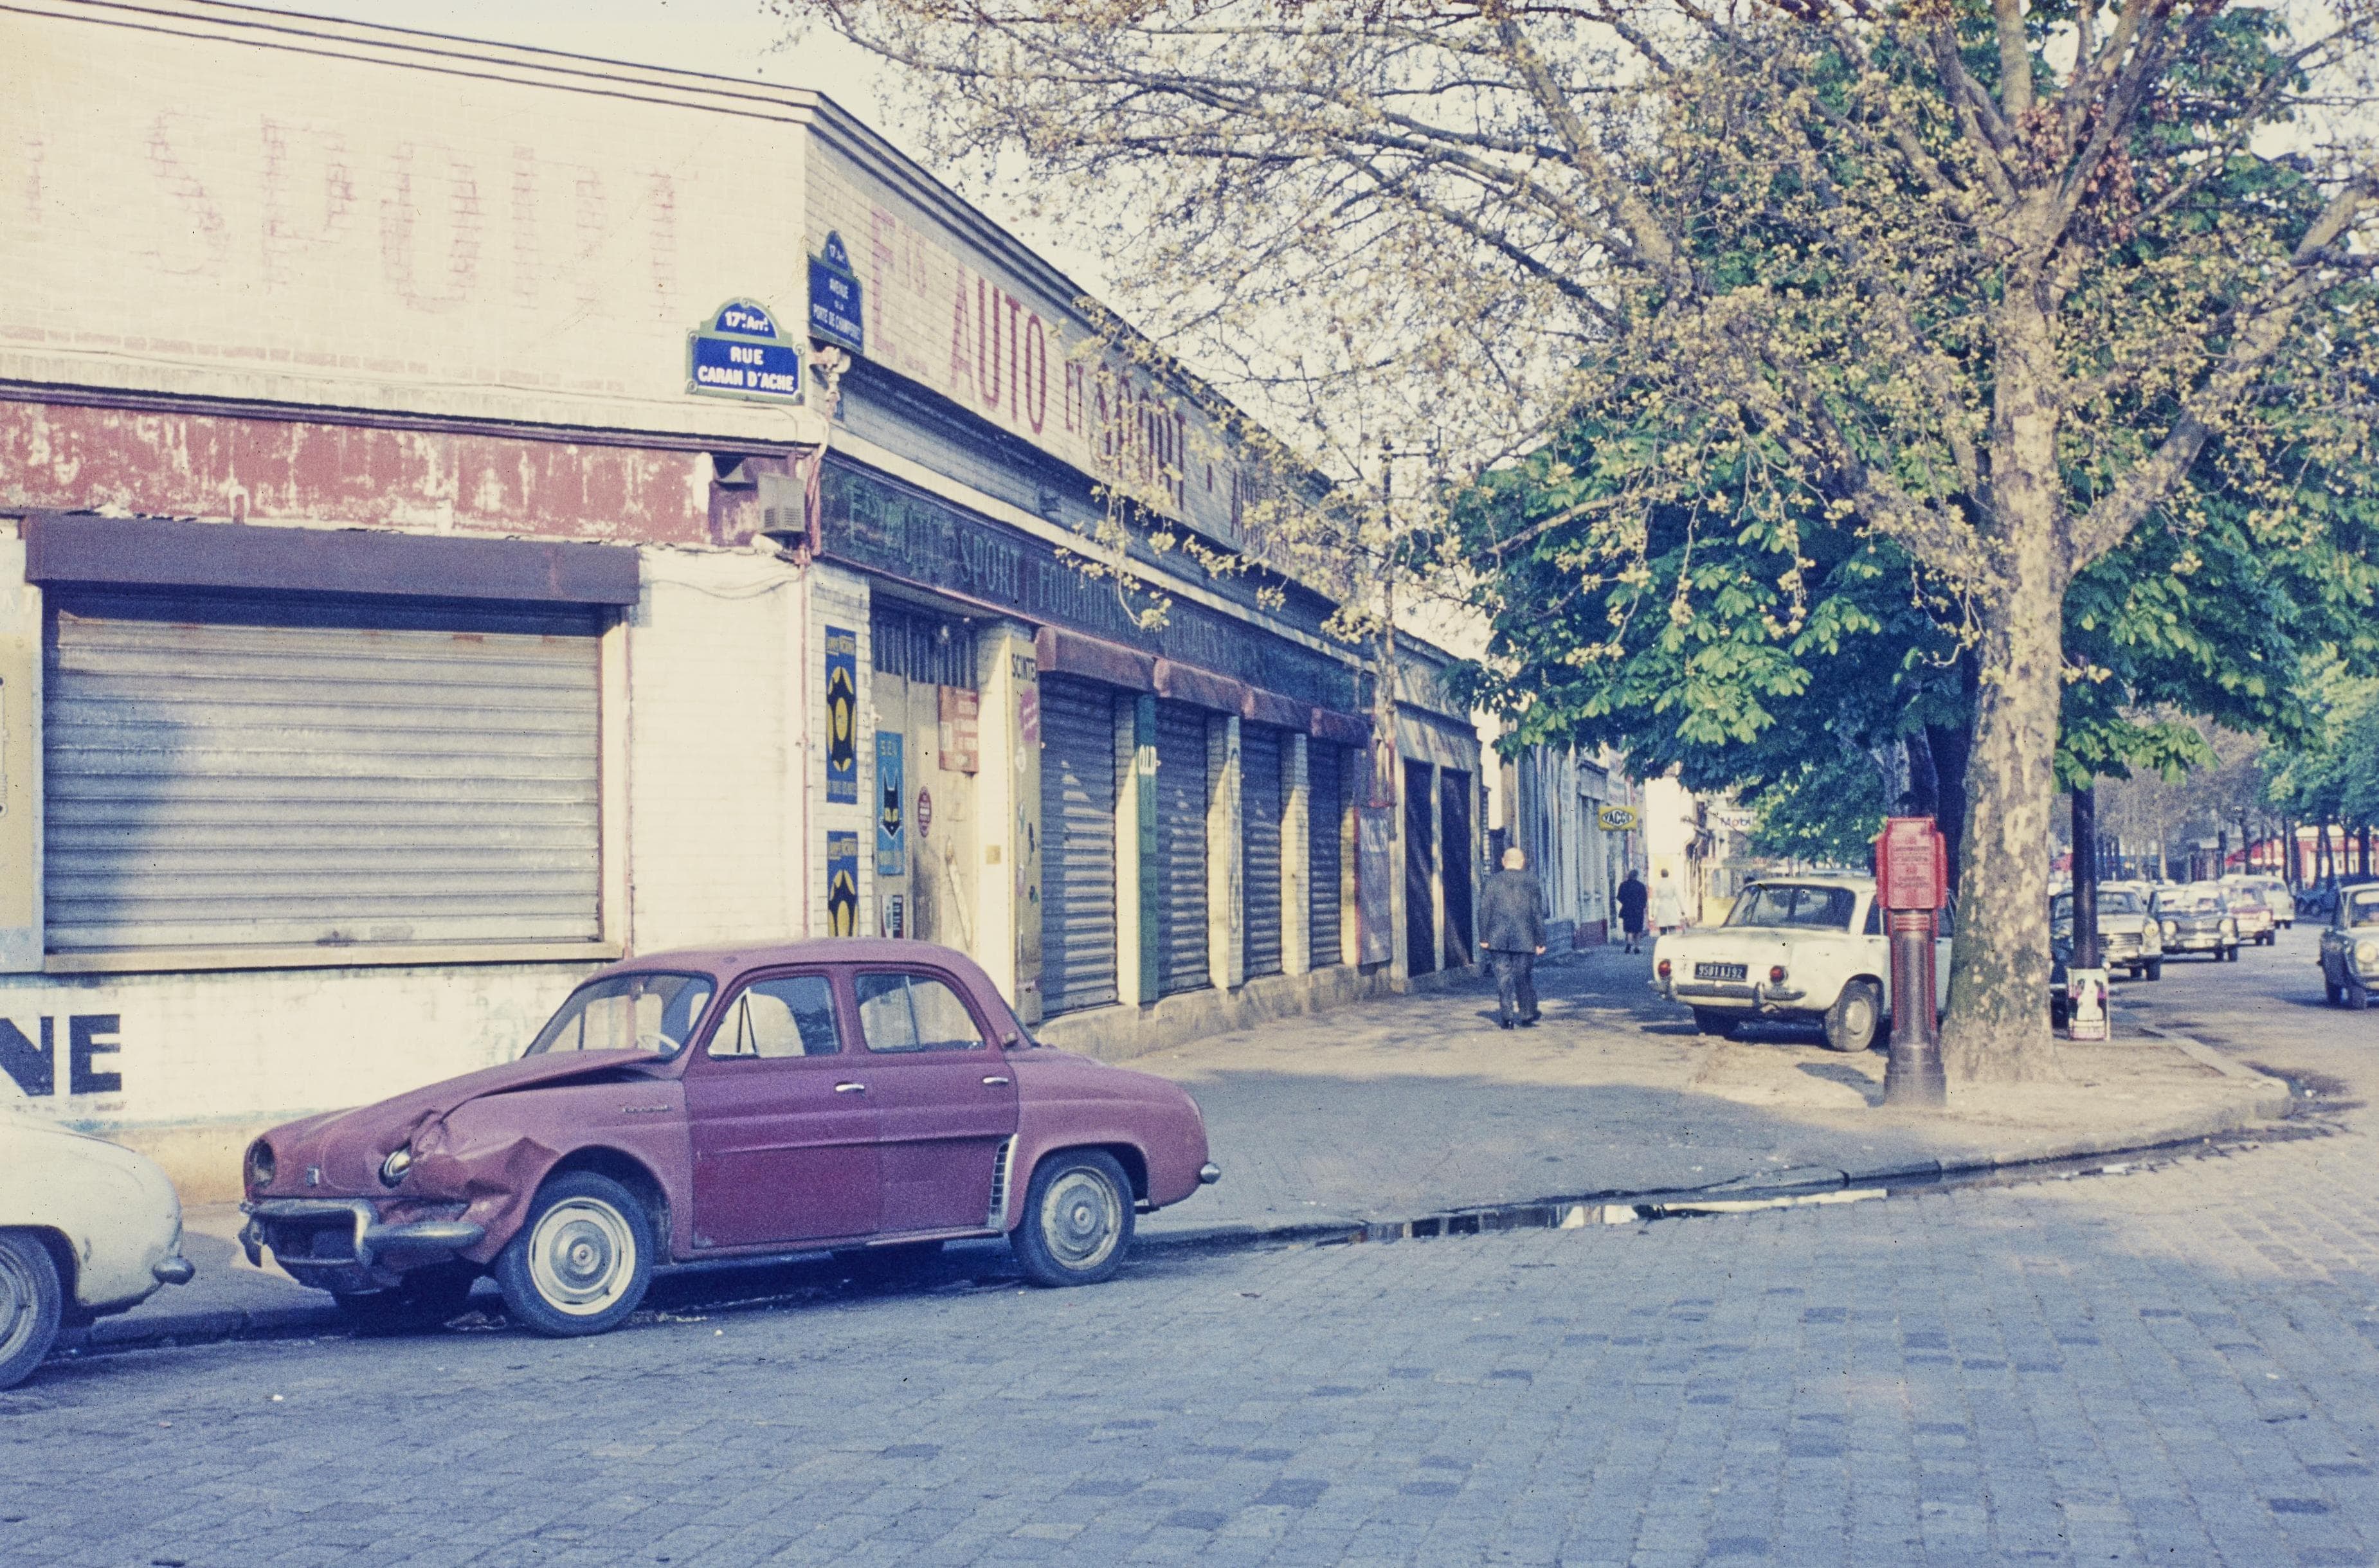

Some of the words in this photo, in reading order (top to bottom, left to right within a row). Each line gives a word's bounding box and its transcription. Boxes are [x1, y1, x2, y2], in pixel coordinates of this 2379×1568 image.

[730, 347, 764, 365] RUE
[950, 260, 1046, 435] AUTO
[1065, 360, 1084, 438] ET
[698, 365, 743, 386] CARAN
[747, 370, 794, 392] D'ACHE
[961, 529, 1021, 602] SPORT
[1720, 815, 1752, 827] Mobil
